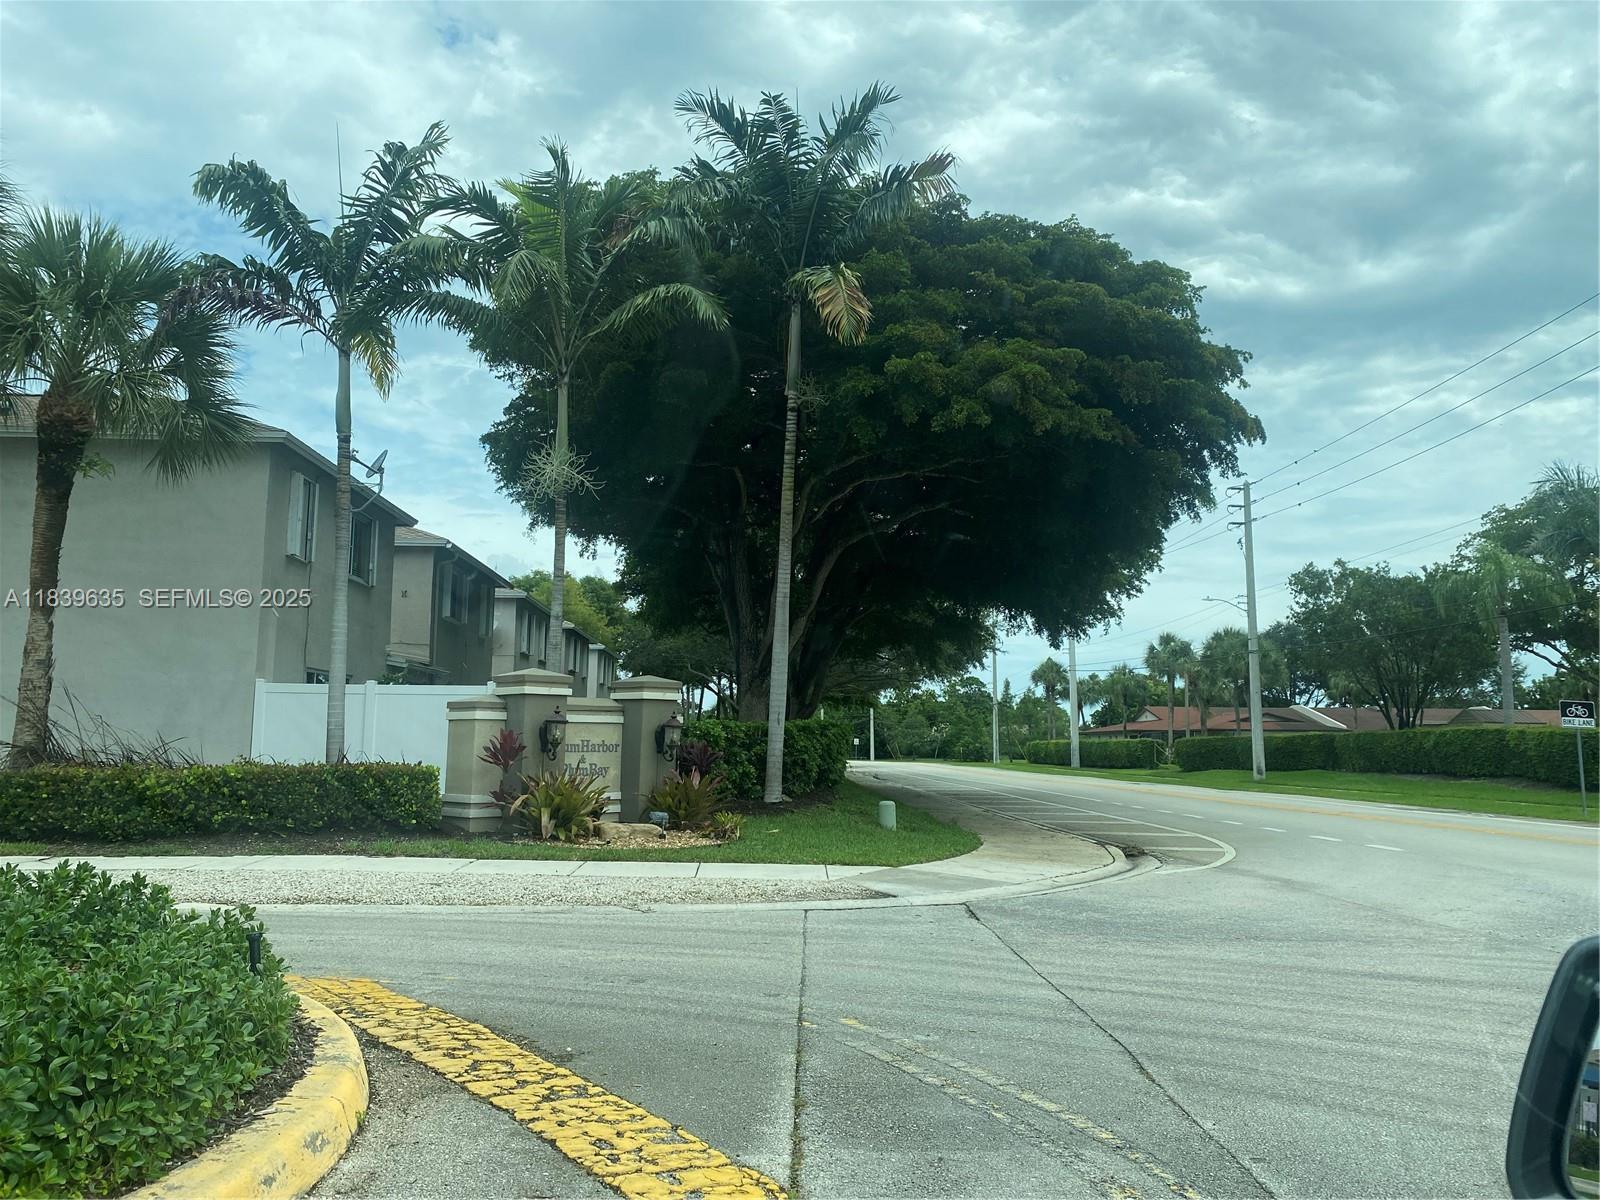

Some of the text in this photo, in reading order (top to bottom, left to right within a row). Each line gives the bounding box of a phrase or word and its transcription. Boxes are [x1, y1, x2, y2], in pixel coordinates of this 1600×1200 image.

[1563, 718, 1594, 727] BIKE LANE
[565, 739, 620, 753] umHarbor
[580, 754, 587, 763] &
